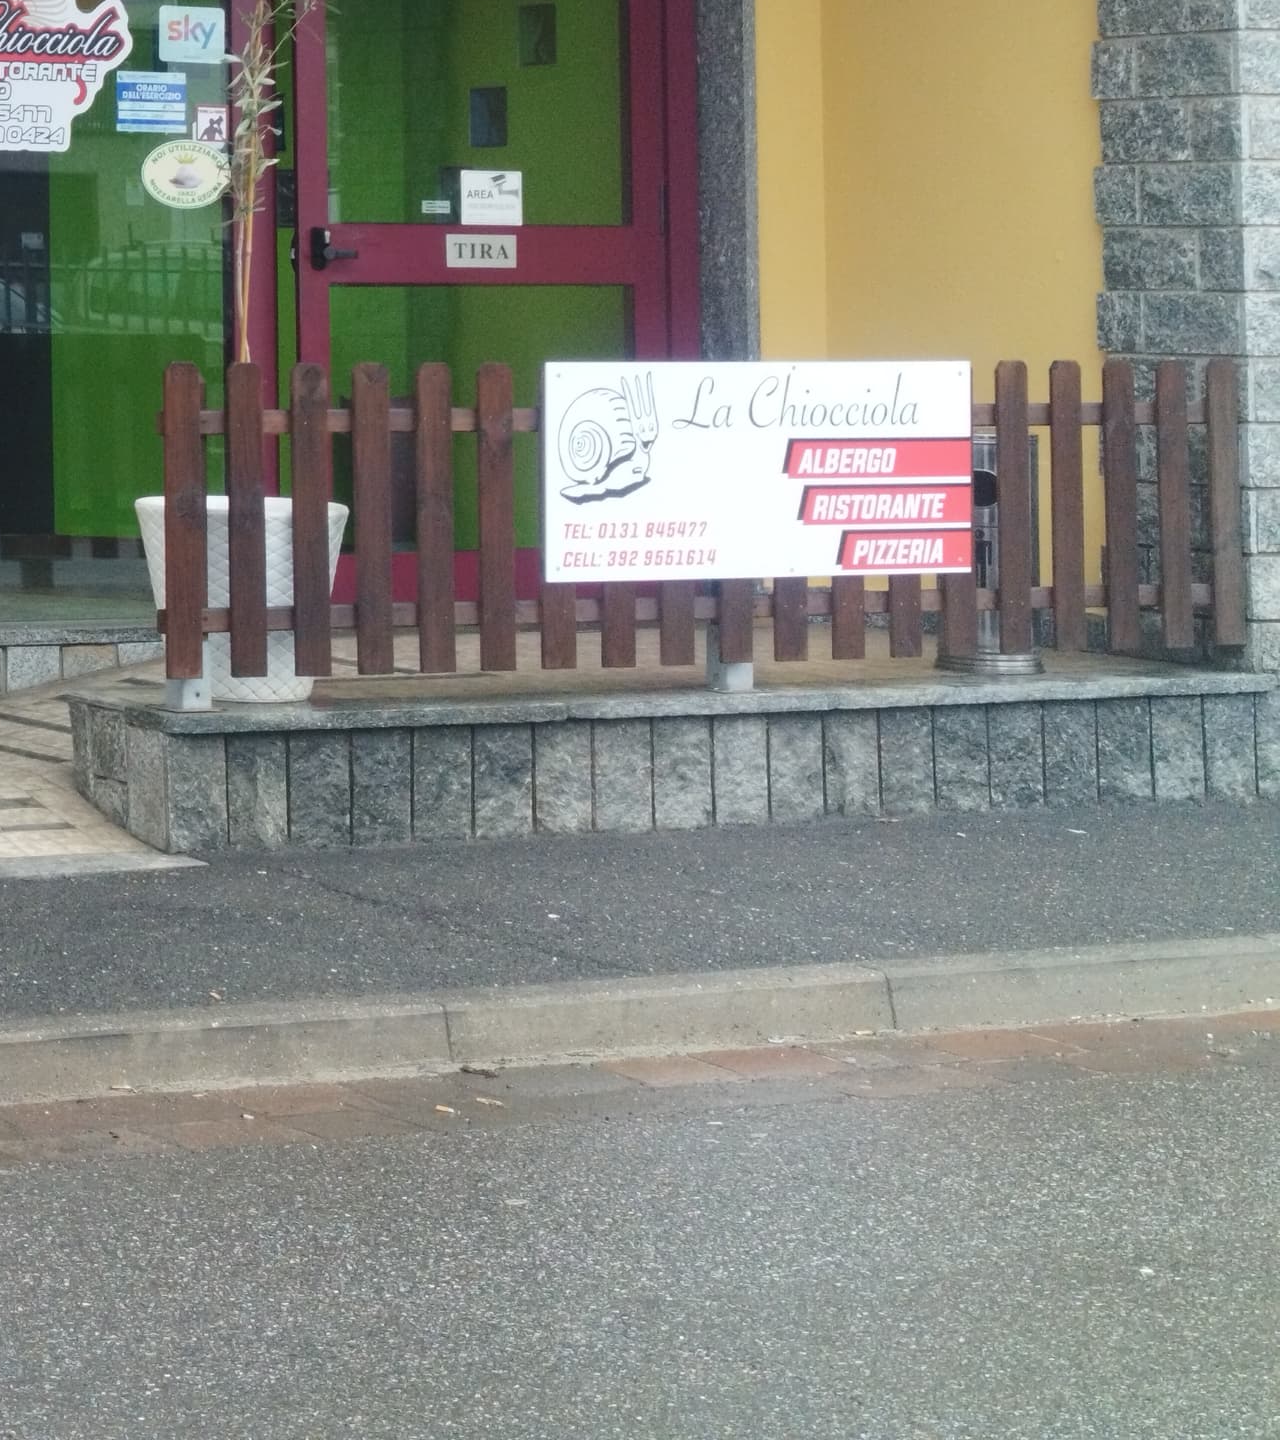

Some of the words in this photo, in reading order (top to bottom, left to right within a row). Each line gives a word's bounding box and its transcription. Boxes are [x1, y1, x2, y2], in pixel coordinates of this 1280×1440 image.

[168, 14, 217, 49] sky
[136, 84, 168, 92] ORARIO
[6, 125, 64, 144] 0424
[151, 151, 166, 164] NOI
[466, 190, 494, 199] AREA
[453, 242, 508, 260] TIRA
[672, 376, 733, 429] La
[748, 372, 919, 428] Chiocciola
[797, 448, 896, 474] ALBERGO
[812, 493, 946, 521] RISTORANTE
[564, 523, 592, 539] TEL:
[598, 522, 638, 539] 0131
[645, 521, 707, 538] 845477
[563, 551, 602, 567] CELL:
[607, 550, 638, 567] 392
[852, 538, 944, 566] PIZZERIA
